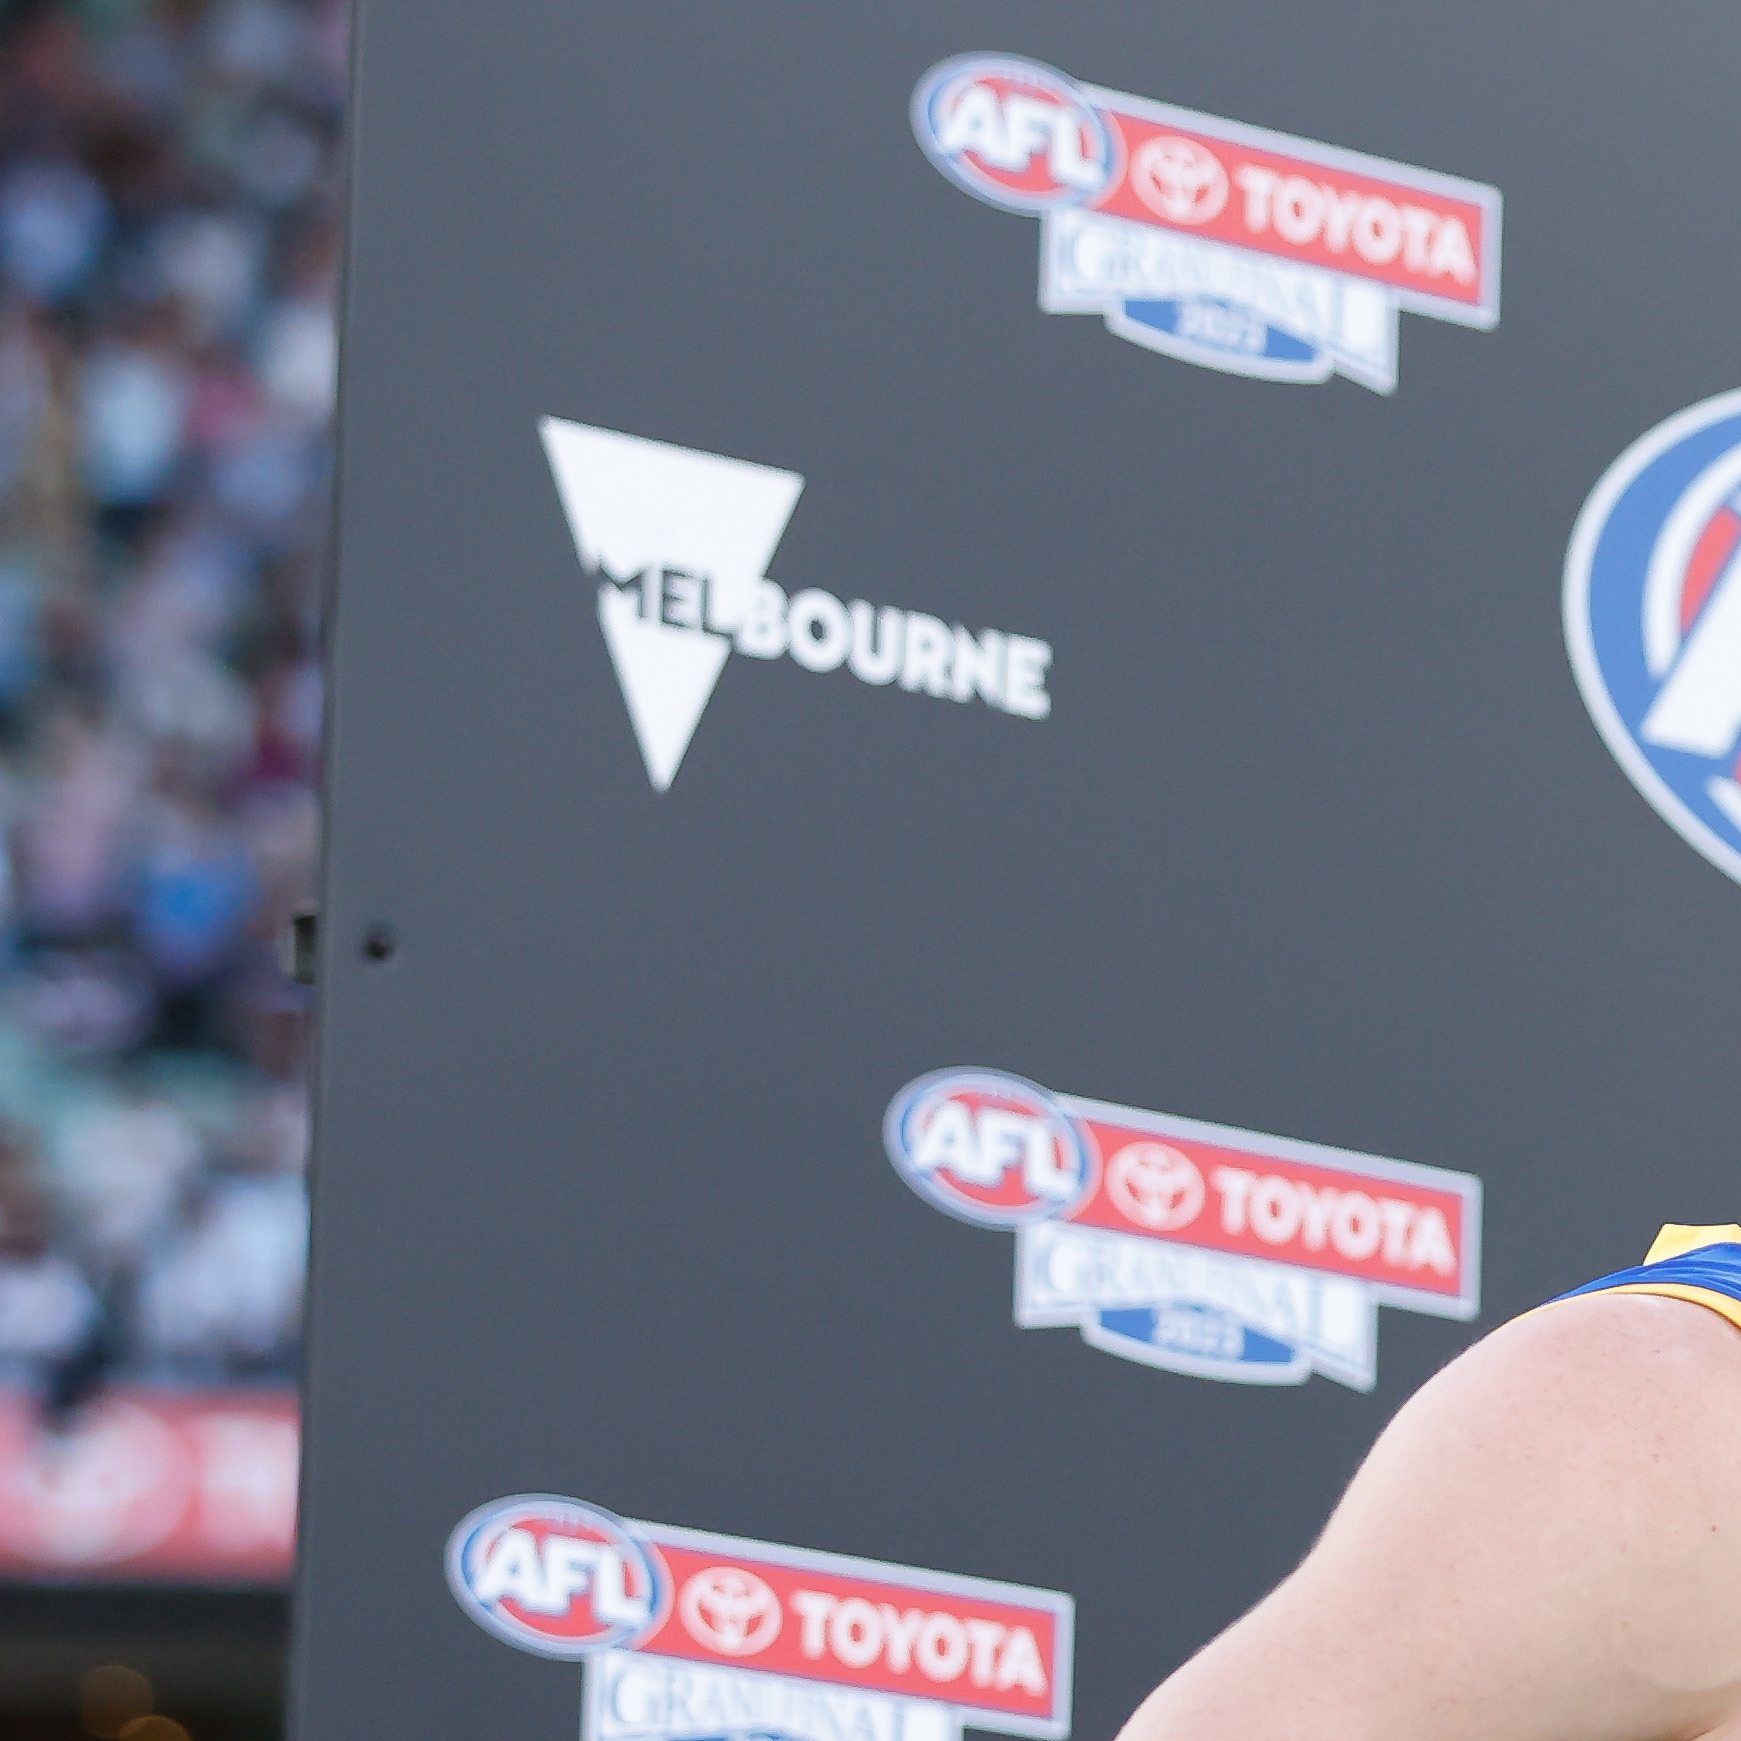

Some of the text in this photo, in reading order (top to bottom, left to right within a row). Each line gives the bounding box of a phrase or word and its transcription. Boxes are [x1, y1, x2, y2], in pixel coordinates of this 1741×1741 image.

[936, 82, 1106, 194] AFL
[1235, 165, 1478, 286] TOYOTA
[594, 557, 1053, 721] MELBOURNE
[910, 1098, 1078, 1198] AFL
[1211, 1165, 1458, 1275] TOYOTA
[477, 1526, 648, 1626] AFL
[792, 1592, 1048, 1698] TOYOTA
